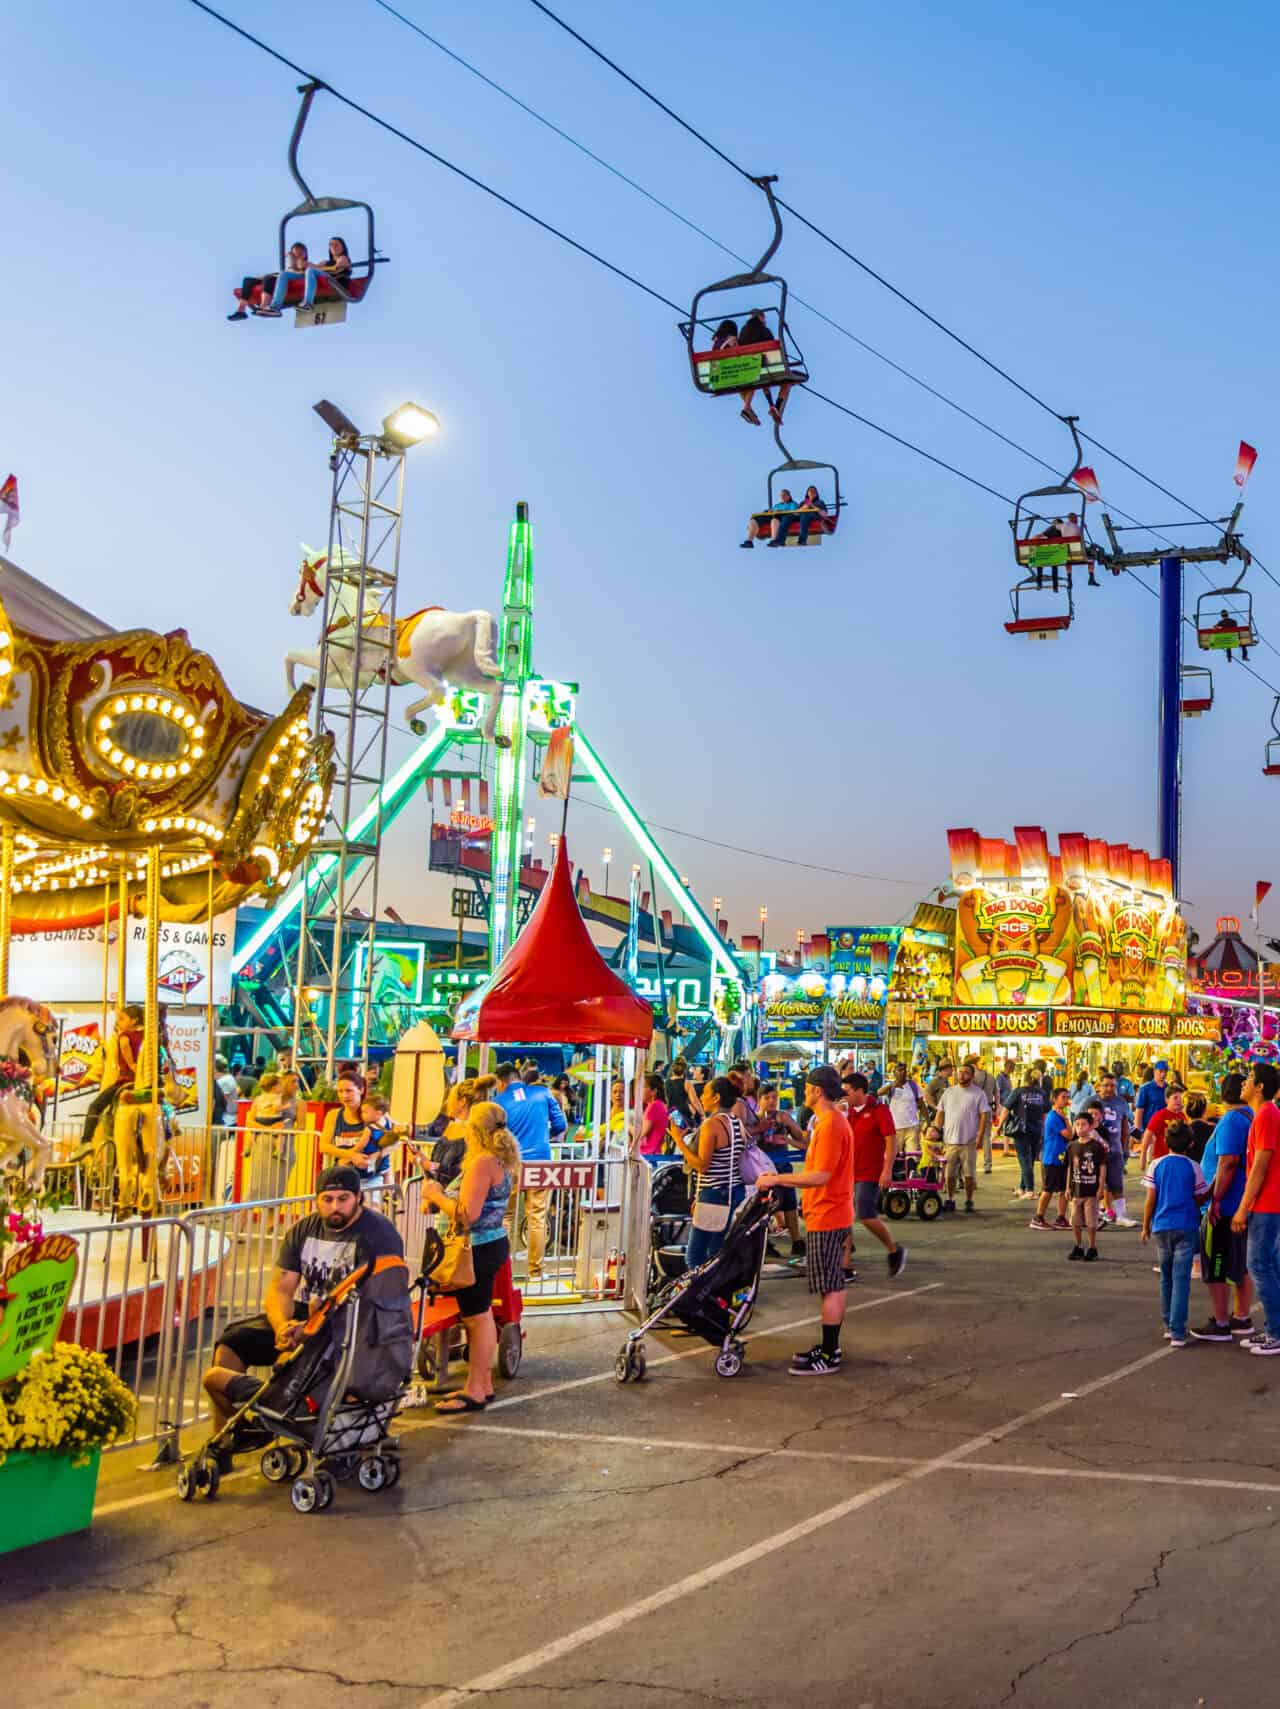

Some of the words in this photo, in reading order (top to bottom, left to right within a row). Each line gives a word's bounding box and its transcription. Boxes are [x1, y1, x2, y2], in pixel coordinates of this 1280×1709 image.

[986, 900, 1006, 917] BIG
[1010, 898, 1044, 916] DOGS
[999, 922, 1030, 933] RCS
[1125, 945, 1144, 960] RCS
[950, 1013, 991, 1031] CORN
[995, 1013, 1037, 1031] DOGS
[1056, 1018, 1115, 1034] LEMONADE
[1138, 1016, 1170, 1034] CORN
[1176, 1019, 1205, 1036] DOGS
[524, 1167, 592, 1187] EXIT
